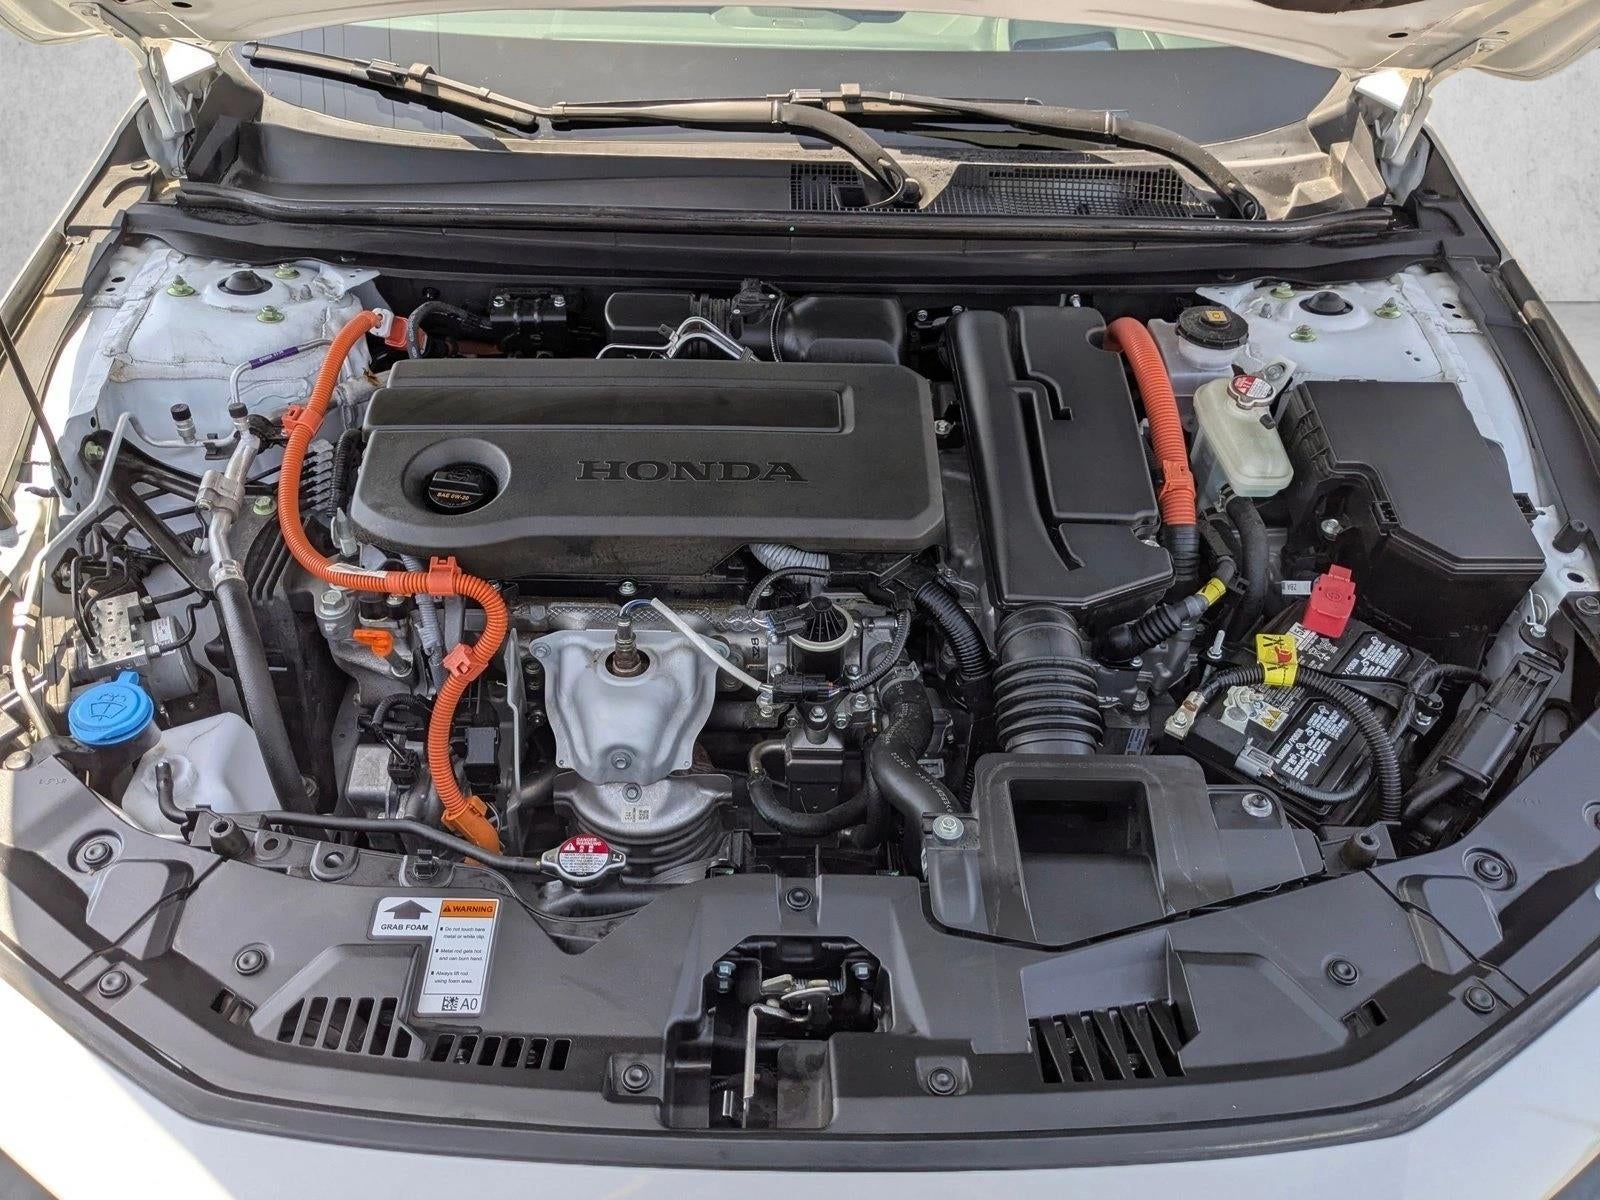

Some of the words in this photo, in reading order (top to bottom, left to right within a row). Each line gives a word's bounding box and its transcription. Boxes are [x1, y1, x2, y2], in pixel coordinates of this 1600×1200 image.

[577, 460, 808, 483] HONDA
[453, 905, 493, 913] WARNING
[460, 998, 478, 1010] A0
